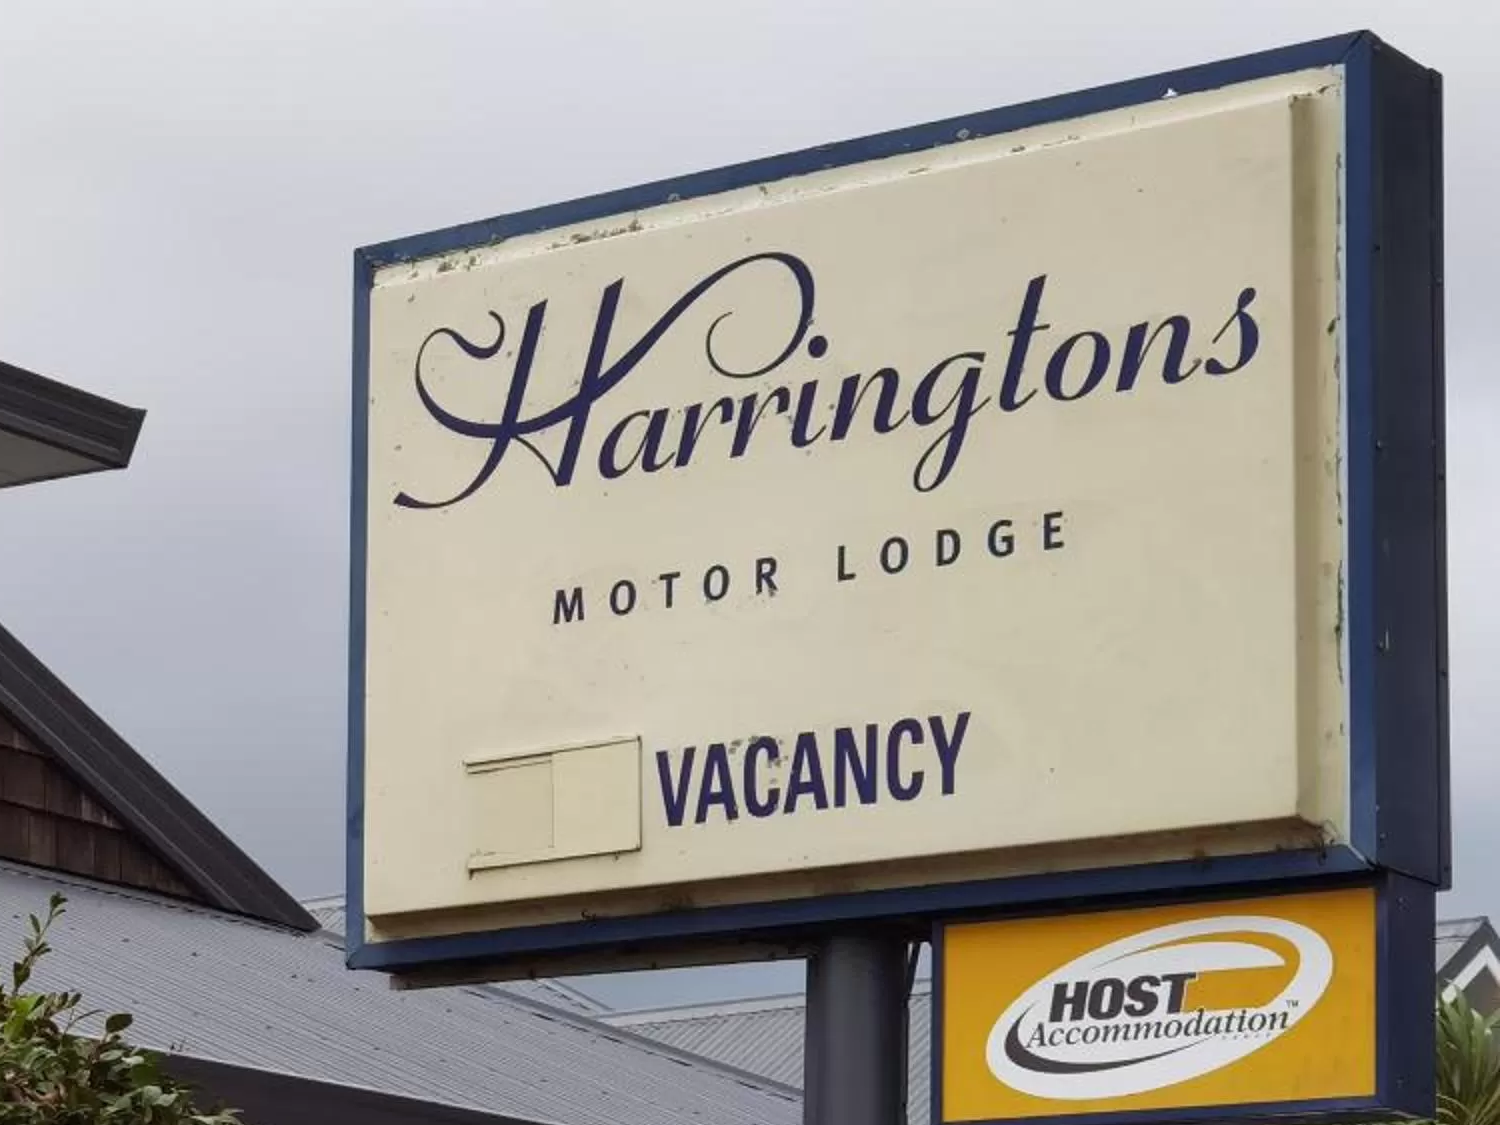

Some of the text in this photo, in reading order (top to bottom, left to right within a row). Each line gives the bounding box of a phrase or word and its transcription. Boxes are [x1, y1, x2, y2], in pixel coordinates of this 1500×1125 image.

[393, 252, 1261, 509] Harringtons
[553, 511, 1067, 625] MOTOR LODGE
[656, 711, 971, 827] VACANCY
[1026, 1006, 1289, 1048] Accommodation
[1048, 971, 1197, 1022] HOST
